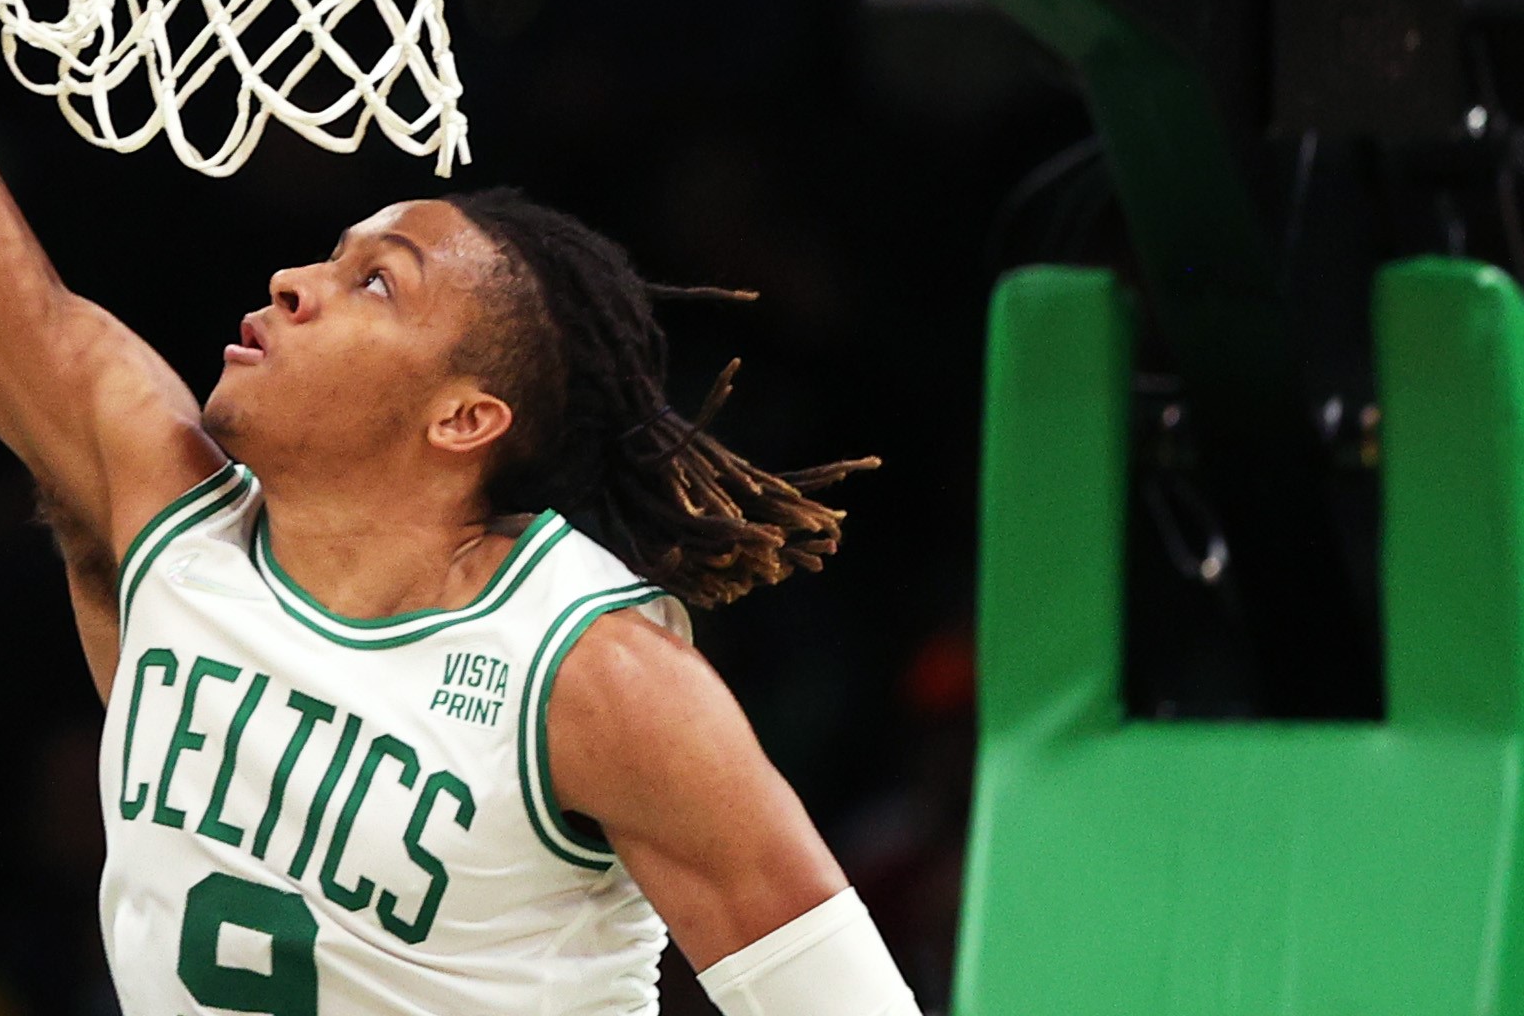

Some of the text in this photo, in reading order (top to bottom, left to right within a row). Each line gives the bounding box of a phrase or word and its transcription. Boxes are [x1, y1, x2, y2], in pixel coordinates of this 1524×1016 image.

[443, 652, 509, 699] VISTA
[429, 689, 504, 727] PRINT
[120, 648, 477, 945] CELTICS
